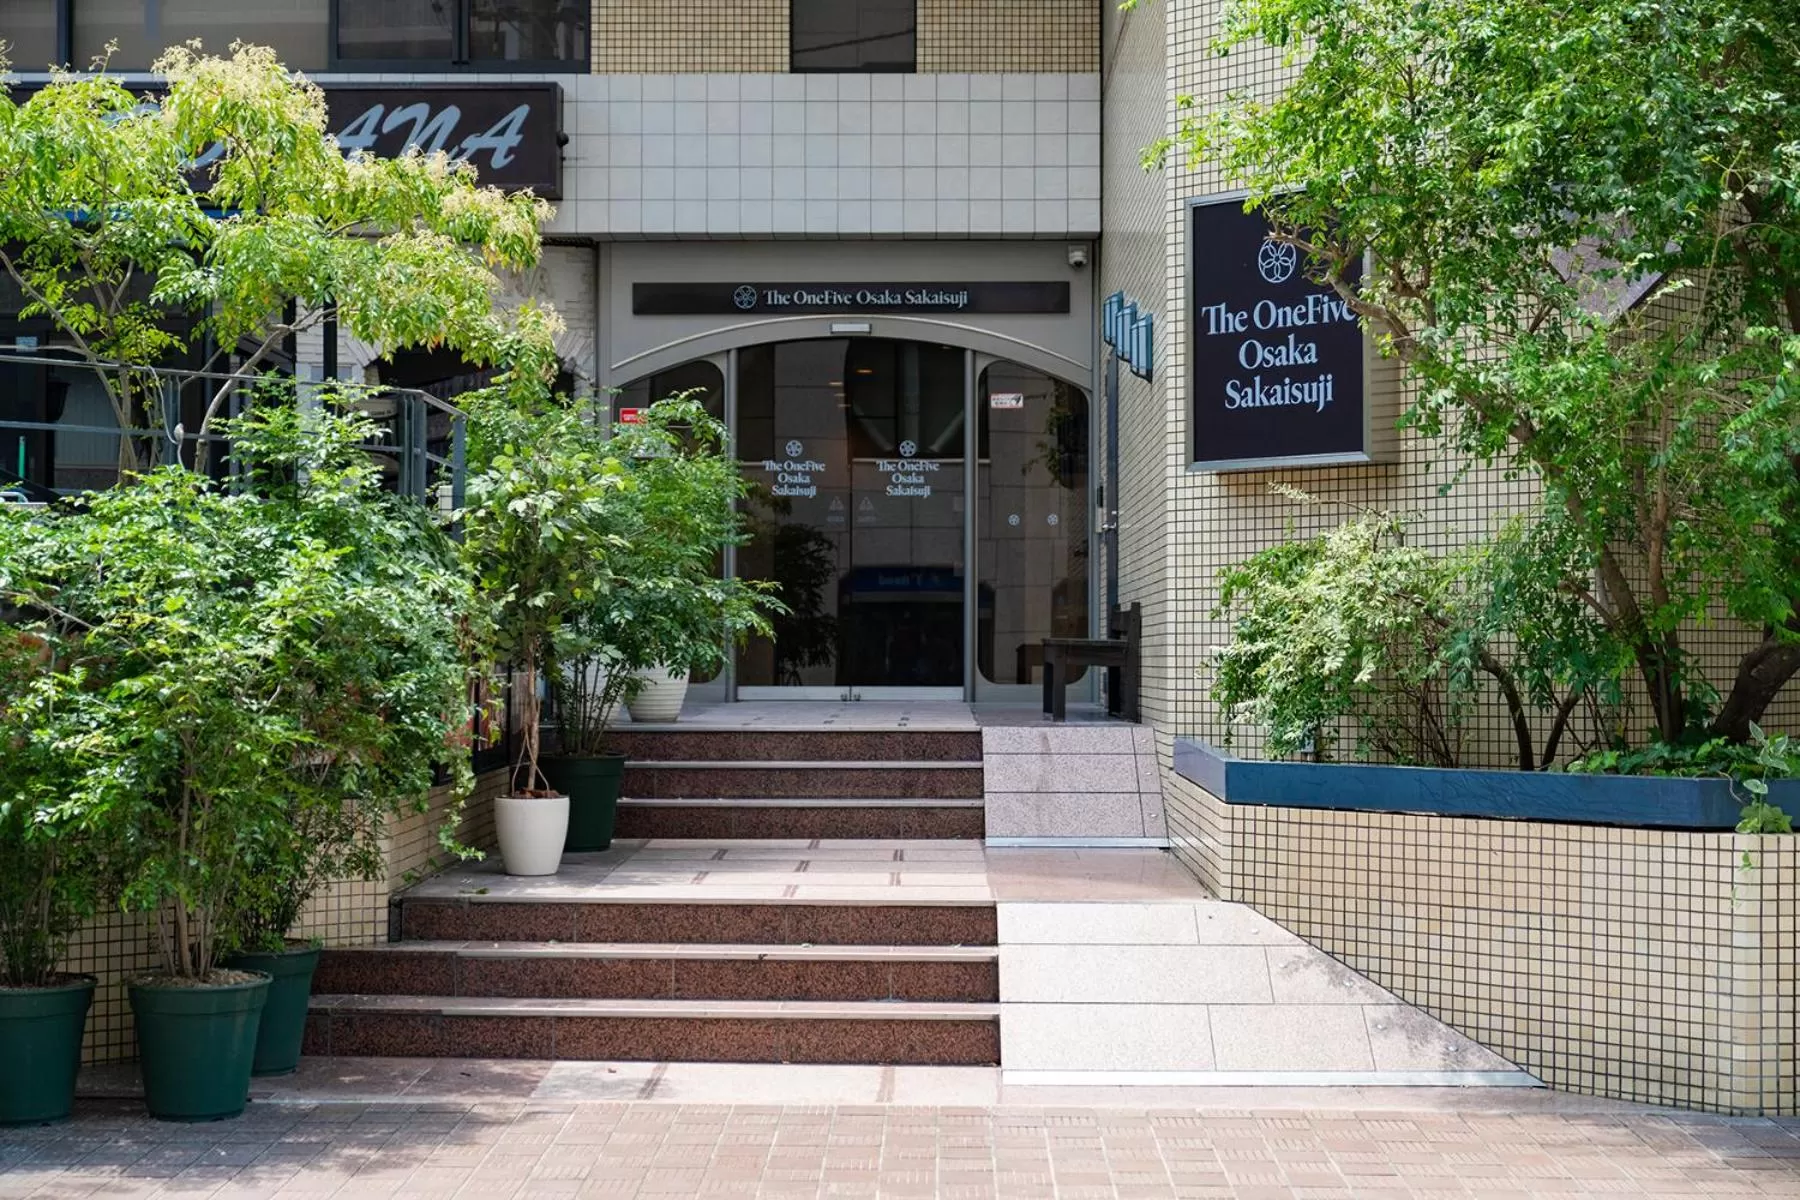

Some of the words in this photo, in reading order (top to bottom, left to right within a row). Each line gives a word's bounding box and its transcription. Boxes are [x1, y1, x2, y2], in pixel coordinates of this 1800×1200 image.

[764, 289, 791, 305] The
[793, 289, 852, 305] OneFive
[856, 289, 902, 305] Osaka
[904, 289, 969, 309] Sakaisuji
[1201, 302, 1249, 336] The
[1238, 333, 1319, 370] Osaka
[1224, 374, 1334, 413] Sakaisuji
[763, 460, 783, 472] The
[784, 460, 826, 472] OneFive
[877, 460, 897, 472] The
[898, 460, 940, 472] OneFive
[777, 472, 811, 484] Osaka
[891, 472, 925, 484] Osaka
[772, 484, 817, 498] Sakaisuji
[886, 484, 931, 498] Sakaisuji
